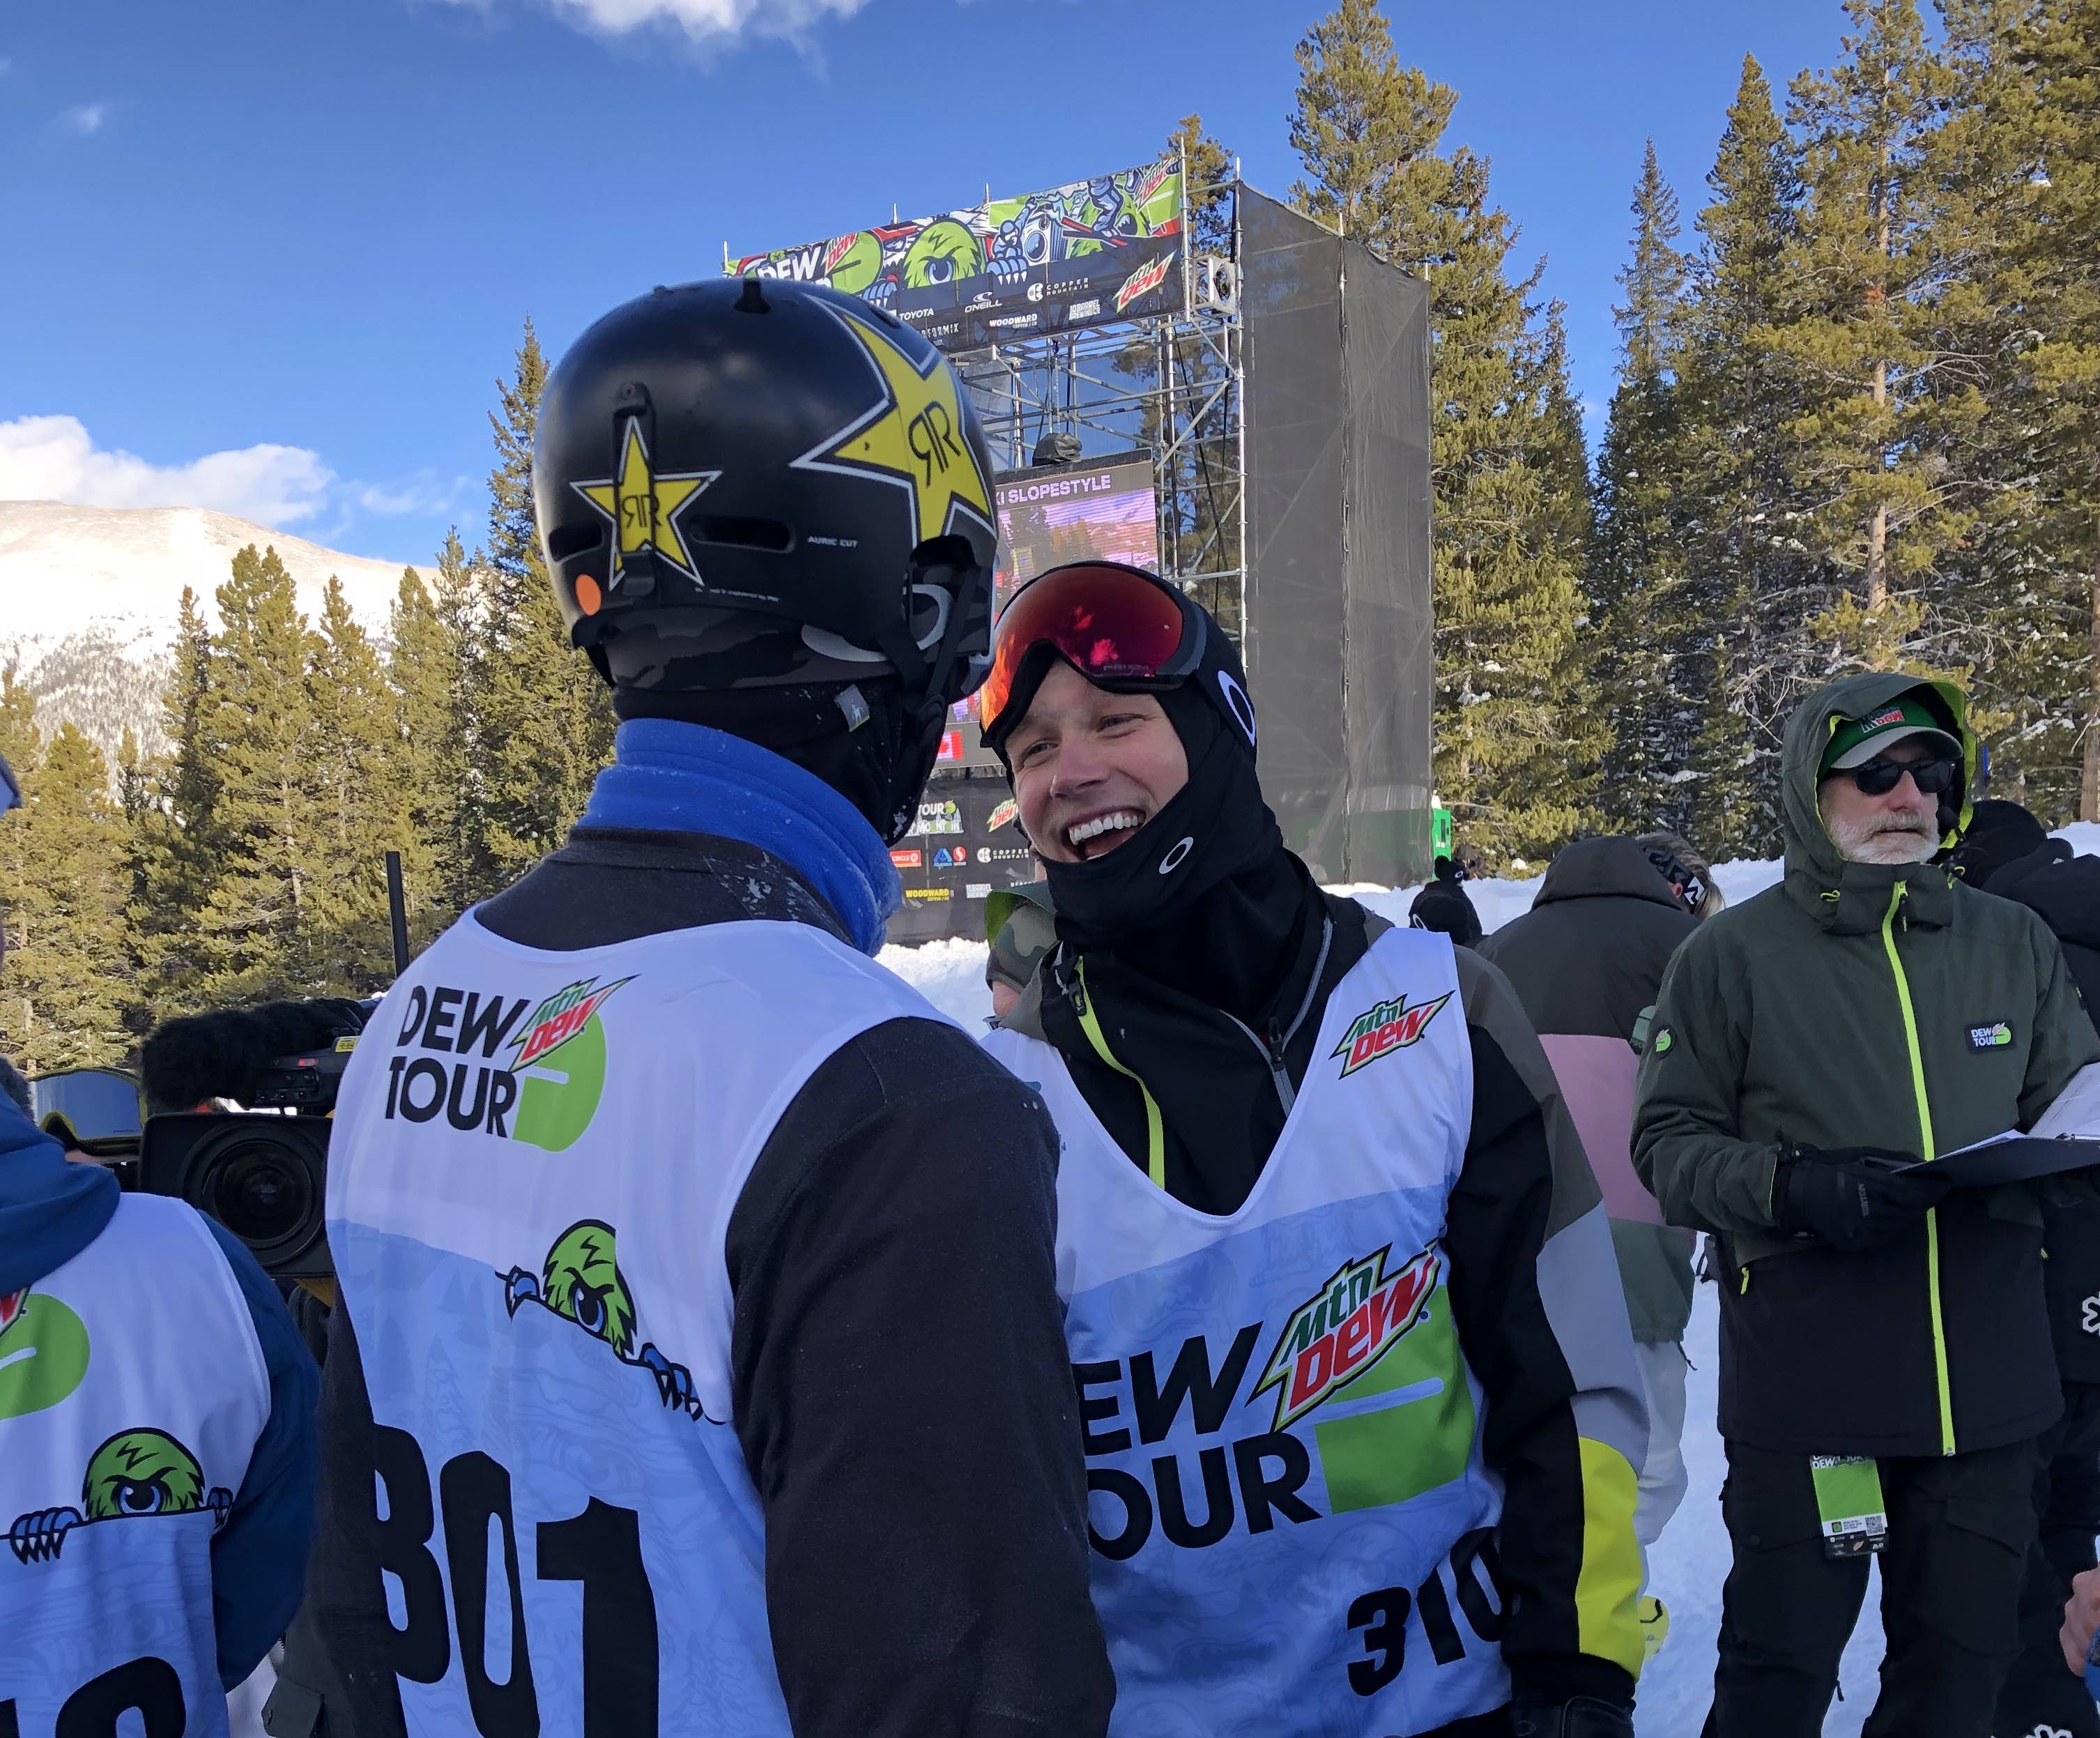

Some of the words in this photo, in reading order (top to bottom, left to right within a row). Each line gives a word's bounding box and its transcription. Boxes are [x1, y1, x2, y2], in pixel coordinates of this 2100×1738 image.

[1046, 277, 1089, 291] COPPER
[1046, 284, 1089, 296] MOUNTAIN
[898, 307, 935, 321] TOYOTA
[989, 313, 1038, 327] WOODWARD
[919, 322, 960, 339] RFORMIX
[1008, 474, 1112, 504] SLOPESTYLE
[806, 535, 838, 546] AURIC
[839, 539, 859, 548] CUT
[906, 889, 949, 899] WOODWARD
[397, 984, 531, 1058] DEW
[1348, 1005, 1399, 1044] Mtn
[1349, 1004, 1435, 1067] Dew
[1970, 1027, 1992, 1038] DEW
[1973, 1036, 1997, 1047] TOUR
[385, 1055, 517, 1138] TOUR
[1280, 1266, 1374, 1366] Mtn
[1288, 1255, 1436, 1412] Dew
[1071, 1320, 1264, 1456] EW
[1087, 1431, 1324, 1562] OUR
[1347, 1525, 1503, 1697] 310
